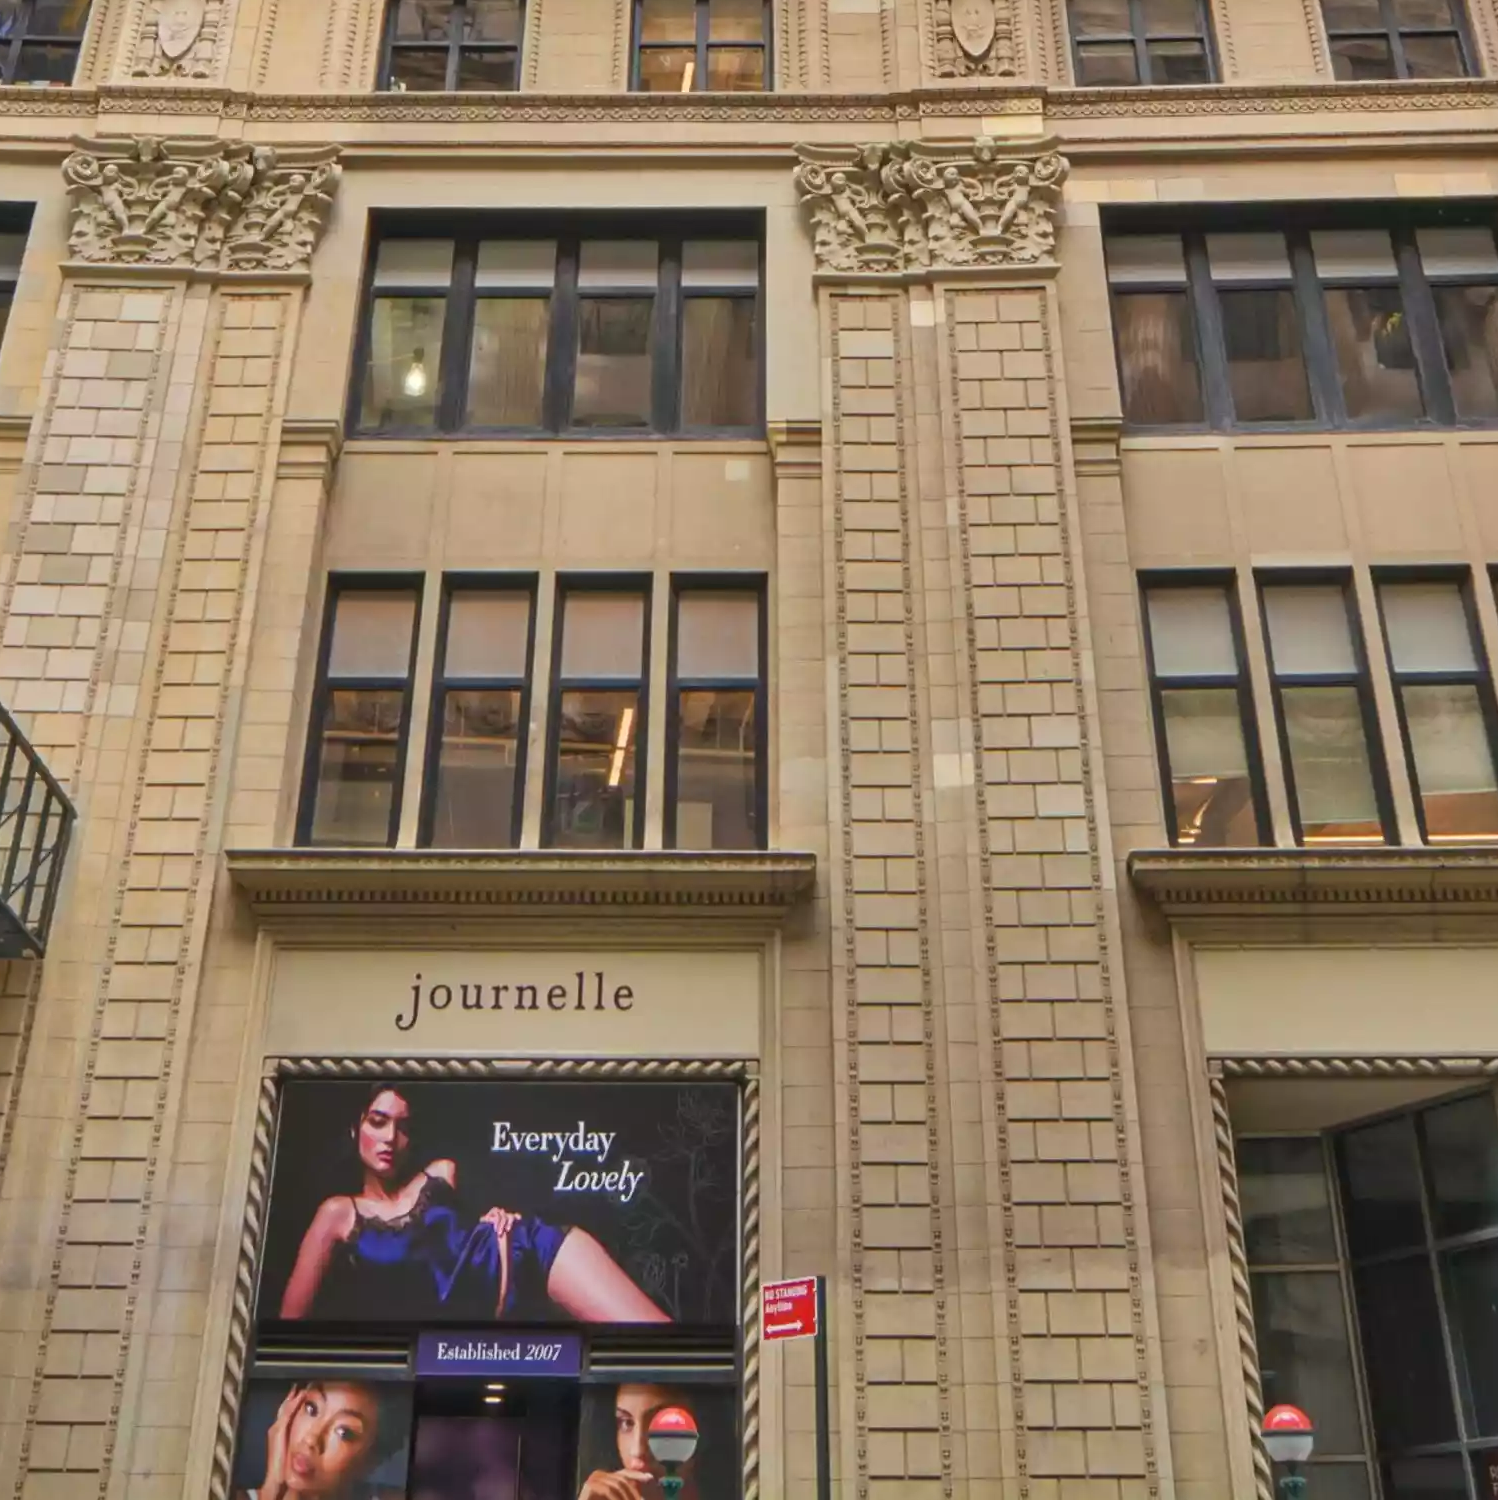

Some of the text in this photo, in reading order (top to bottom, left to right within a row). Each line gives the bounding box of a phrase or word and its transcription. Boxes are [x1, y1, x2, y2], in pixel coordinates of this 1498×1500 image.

[395, 972, 634, 1031] journelle
[491, 1121, 616, 1162] Everyday
[553, 1161, 644, 1202] Lovely
[437, 1342, 562, 1362] Established 2007
